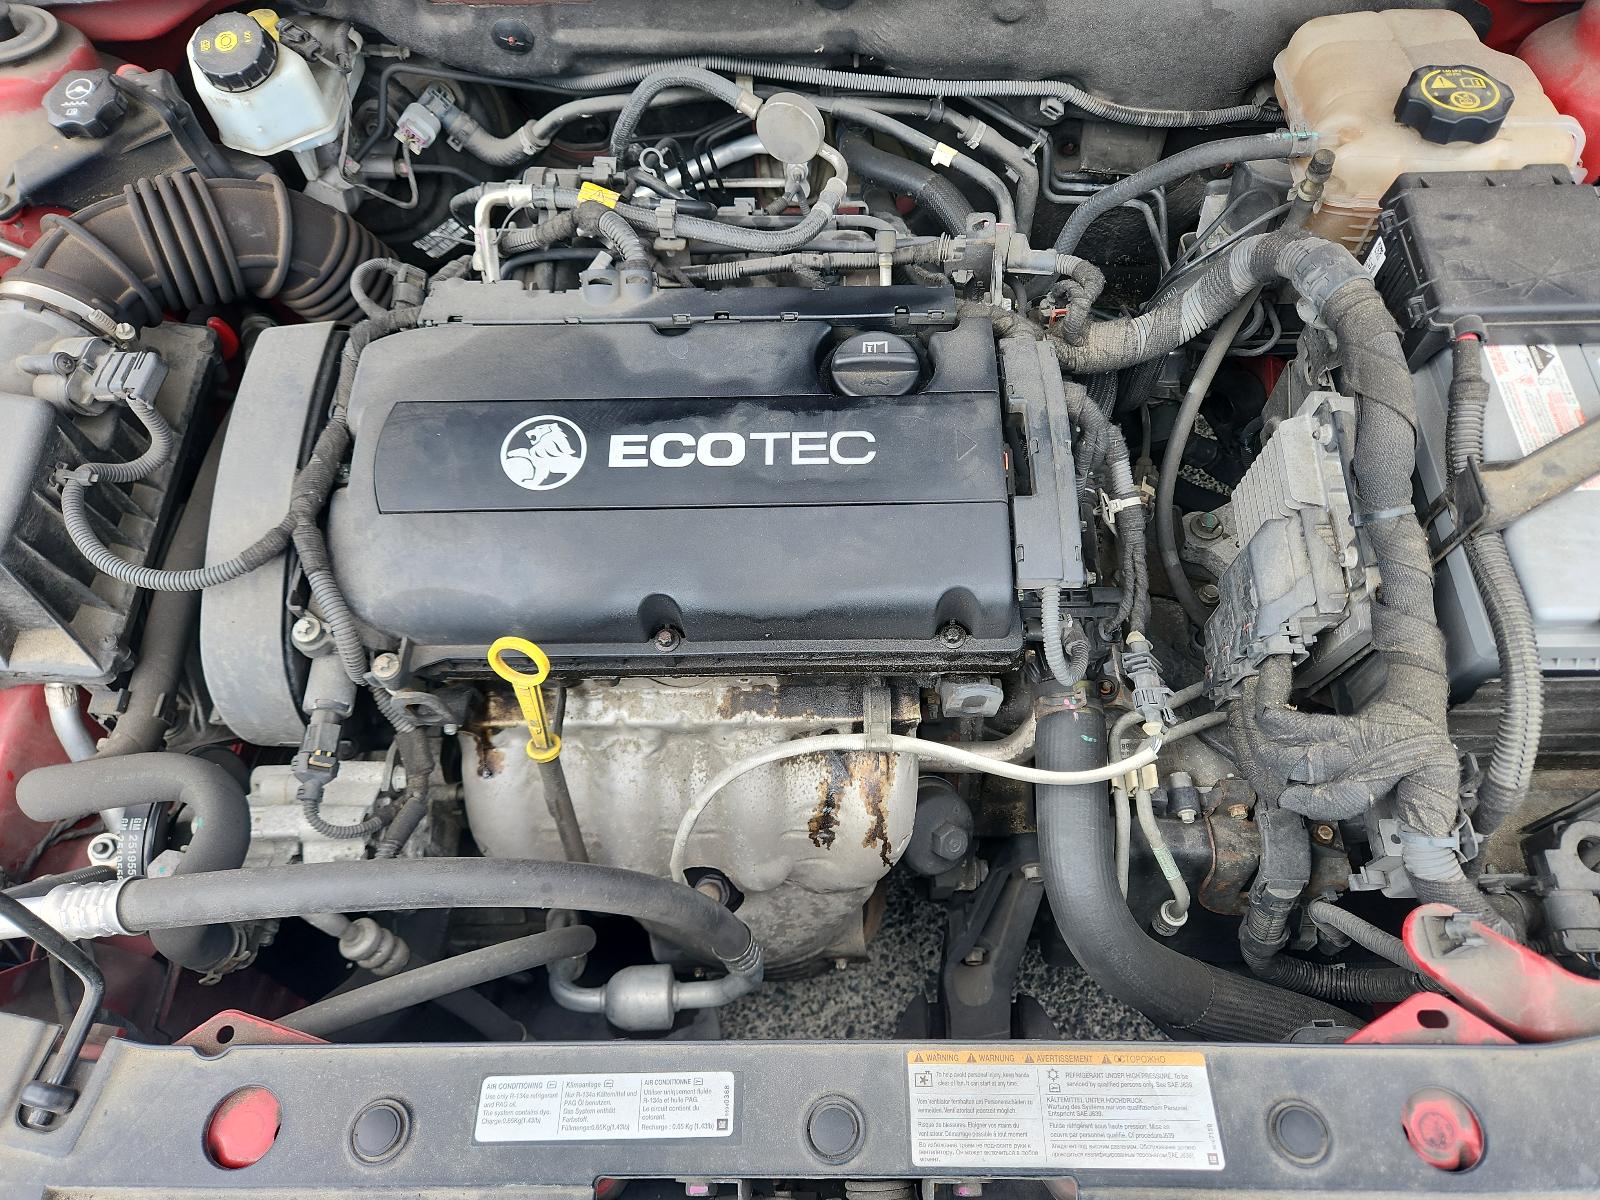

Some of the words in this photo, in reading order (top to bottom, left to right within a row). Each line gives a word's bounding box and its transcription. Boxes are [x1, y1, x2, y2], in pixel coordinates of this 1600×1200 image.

[608, 430, 877, 468] ECOTEC
[127, 834, 138, 877] 251955
[925, 1054, 959, 1062] WARNING
[978, 1054, 1015, 1062] WARNUNG
[1036, 1054, 1093, 1063] AVERTISSEMENT
